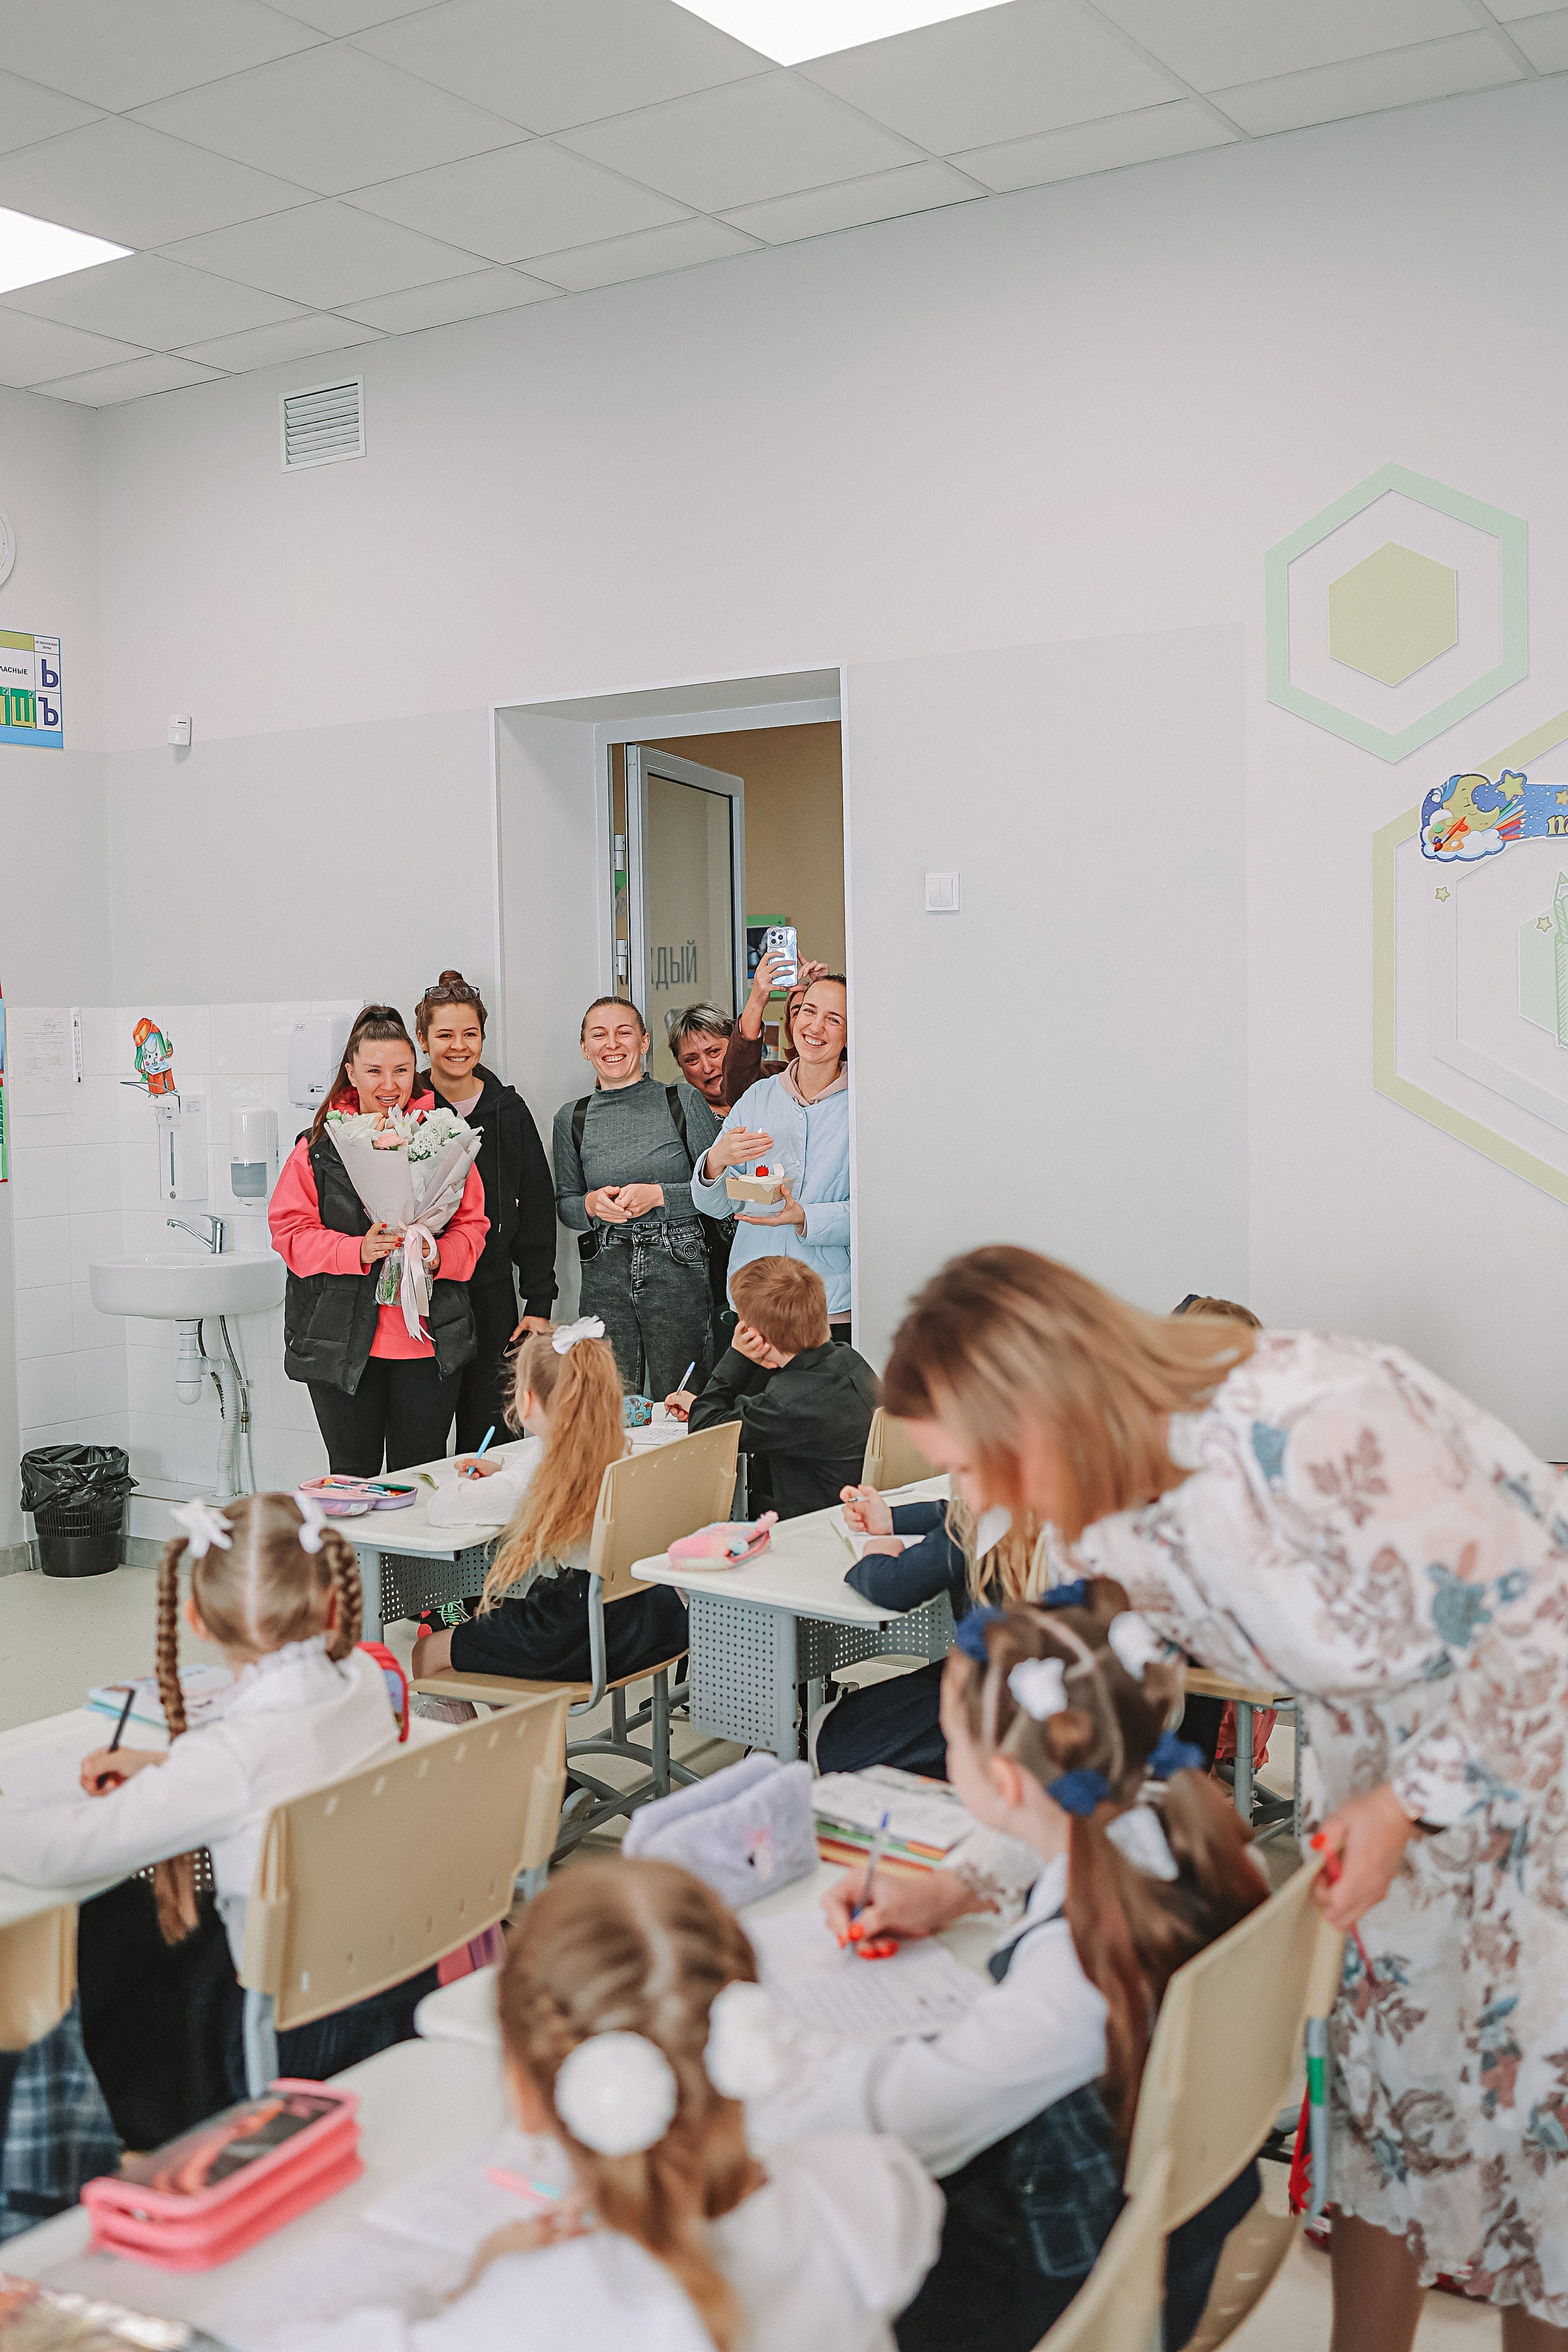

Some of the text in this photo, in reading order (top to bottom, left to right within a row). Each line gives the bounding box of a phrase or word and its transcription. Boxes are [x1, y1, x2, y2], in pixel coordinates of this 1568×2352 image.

[41, 658, 59, 688] Ь
[38, 696, 59, 726] Ъ
[650, 940, 697, 990] ДЫЙ
